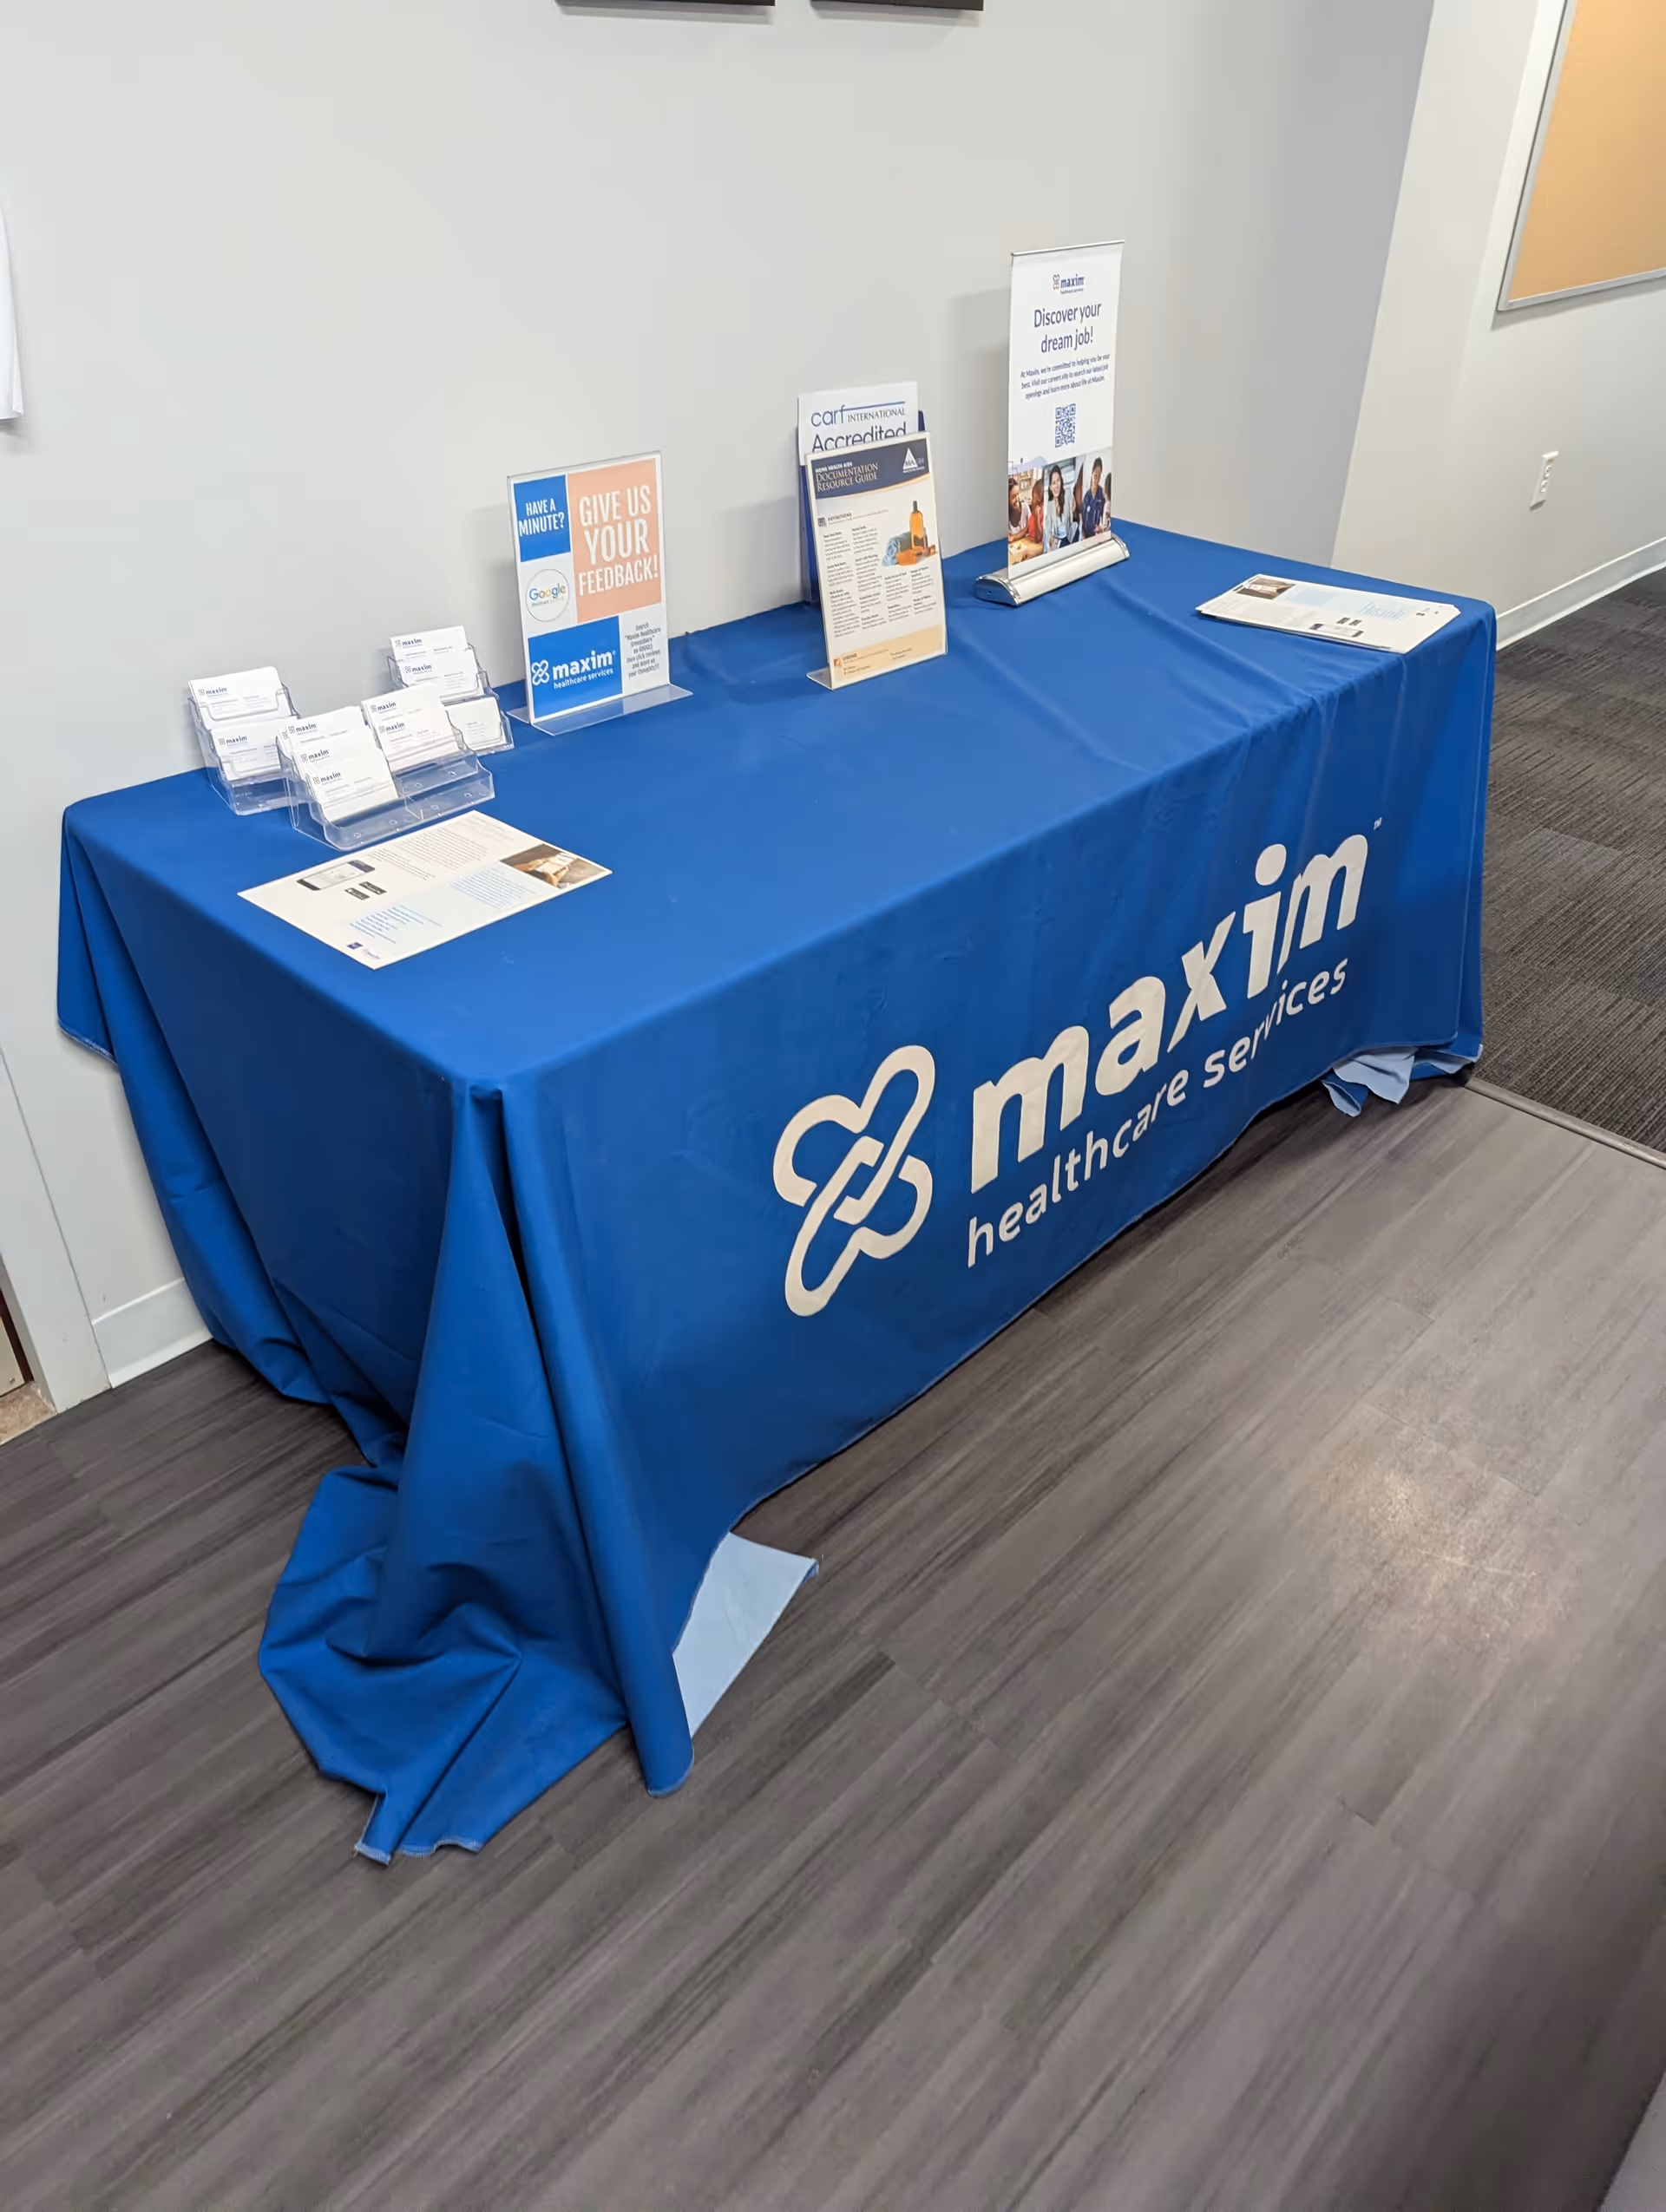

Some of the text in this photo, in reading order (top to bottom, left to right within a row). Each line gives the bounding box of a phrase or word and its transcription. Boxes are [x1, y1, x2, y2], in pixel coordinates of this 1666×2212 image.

[1060, 273, 1085, 288] maxim
[1034, 303, 1102, 328] Discover your
[1040, 325, 1093, 353] dream job!
[1076, 357, 1089, 366] helping
[811, 404, 906, 427] carf INTERNATIONAL
[812, 421, 907, 453] Accredited
[817, 462, 878, 482] DOCUMENTATION
[828, 462, 843, 471] HEALTH
[817, 471, 877, 492] RESOURCE GUIDE
[526, 498, 556, 516] HAVE A
[580, 485, 651, 527] GIVE US
[518, 512, 564, 536] MINUTE?
[584, 519, 650, 565] YOUR
[578, 554, 659, 597] FEEDBACK!
[529, 583, 566, 600] Google
[412, 664, 432, 672] maxim
[553, 650, 613, 680] maxim
[554, 668, 613, 690] healthcare services
[377, 701, 397, 711] maxim
[296, 723, 317, 732] maxim
[386, 721, 405, 731] maxim
[308, 749, 329, 760] maxim
[320, 772, 341, 782] maxim
[971, 834, 1368, 1194] maxim
[967, 958, 1350, 1267] healthcare services
